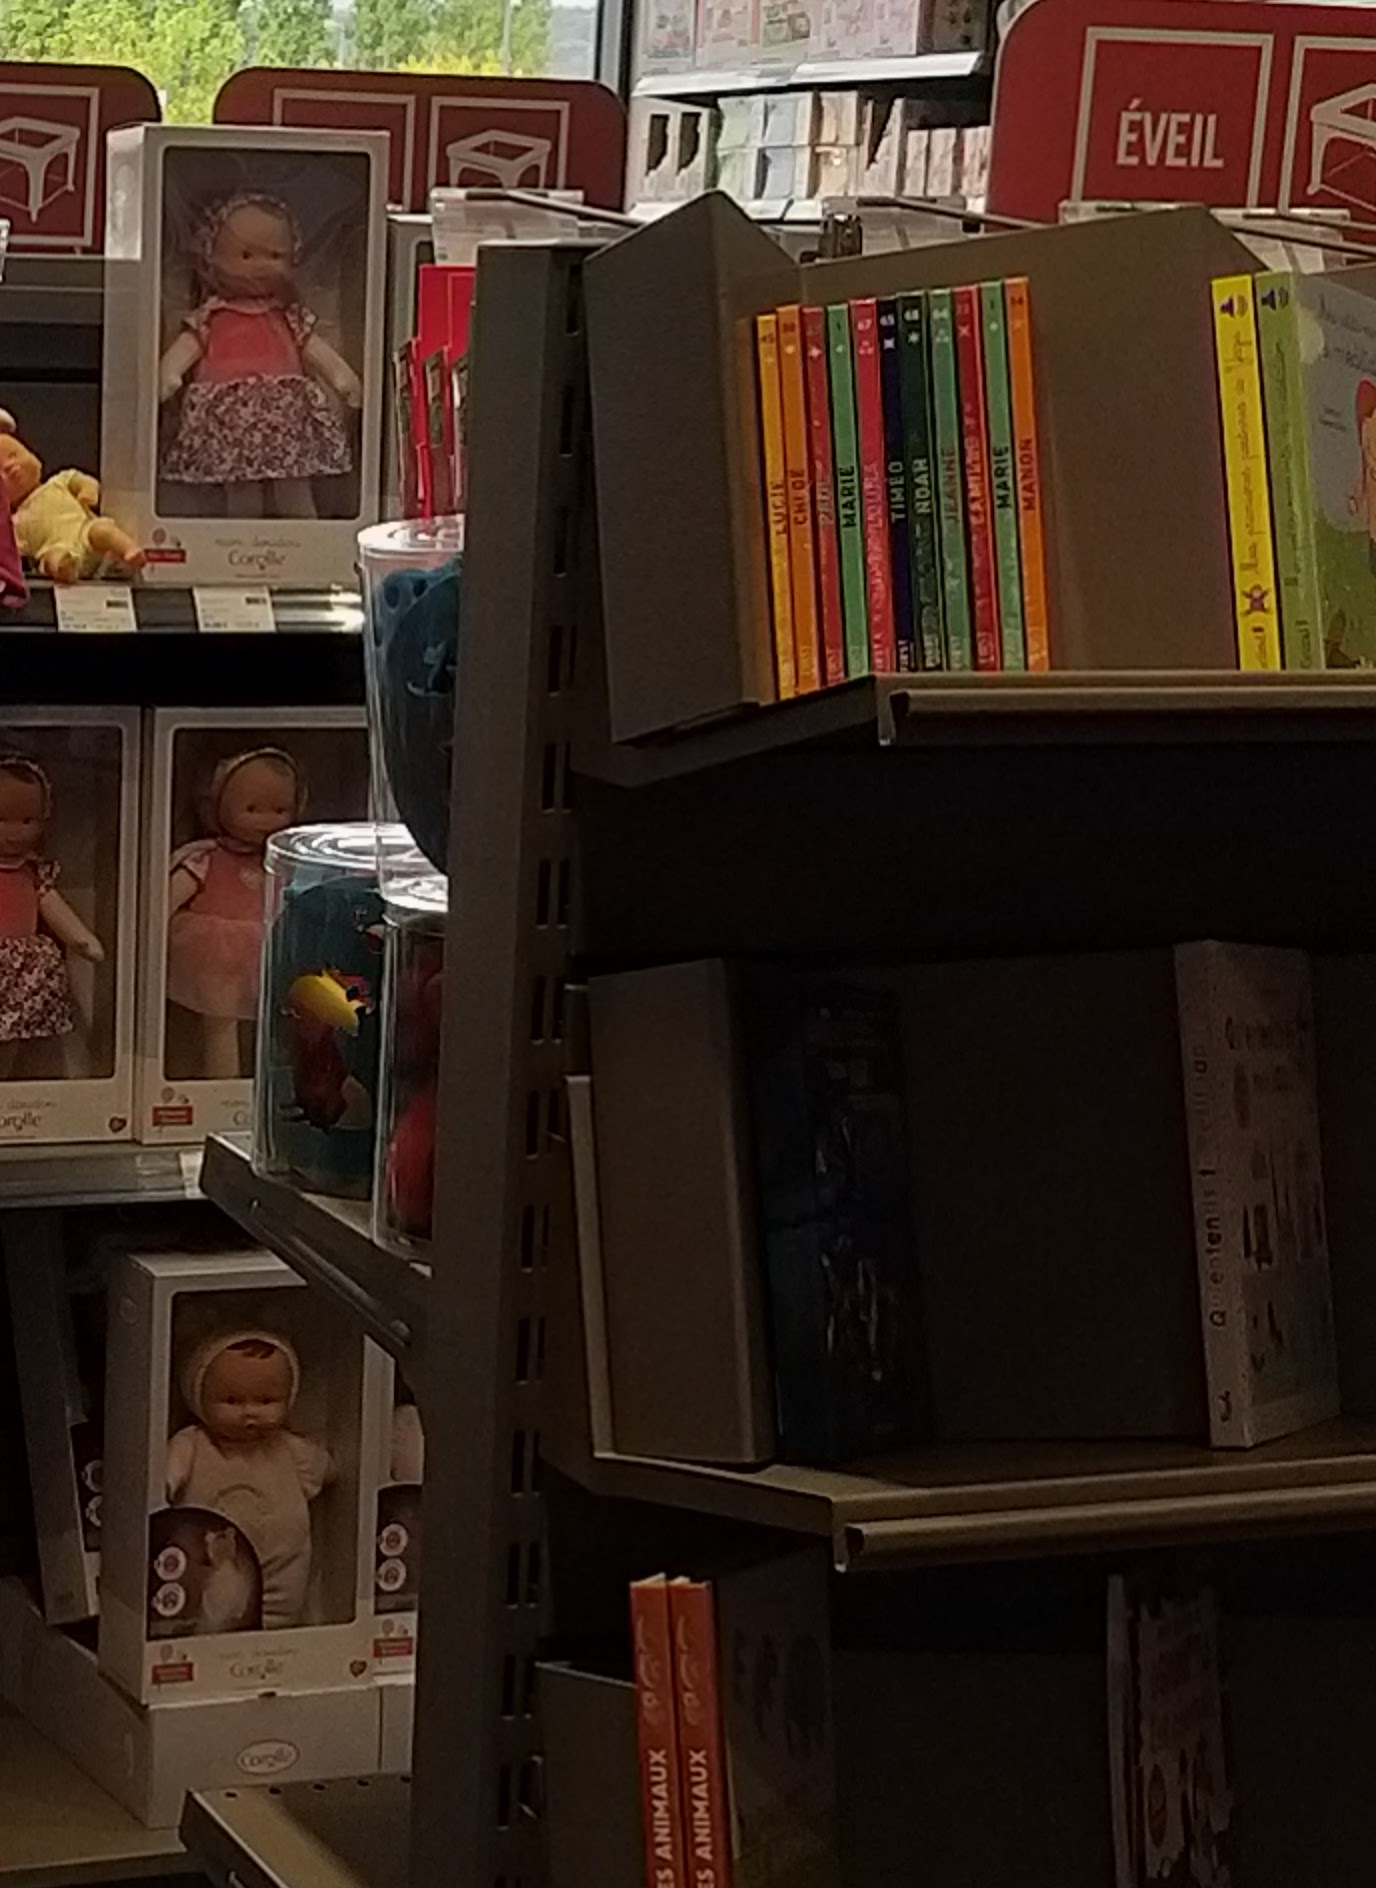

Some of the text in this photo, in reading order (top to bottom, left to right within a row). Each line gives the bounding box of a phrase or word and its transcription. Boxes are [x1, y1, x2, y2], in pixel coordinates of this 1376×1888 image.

[1115, 97, 1225, 169] ÉVEIL
[838, 465, 857, 529] MARIE
[911, 457, 932, 515] NOAH
[993, 445, 1013, 510] MARIE
[1019, 438, 1037, 512] MANON
[647, 1748, 674, 1861] ANIMAUX
[686, 1748, 713, 1862] ANIMAUX
